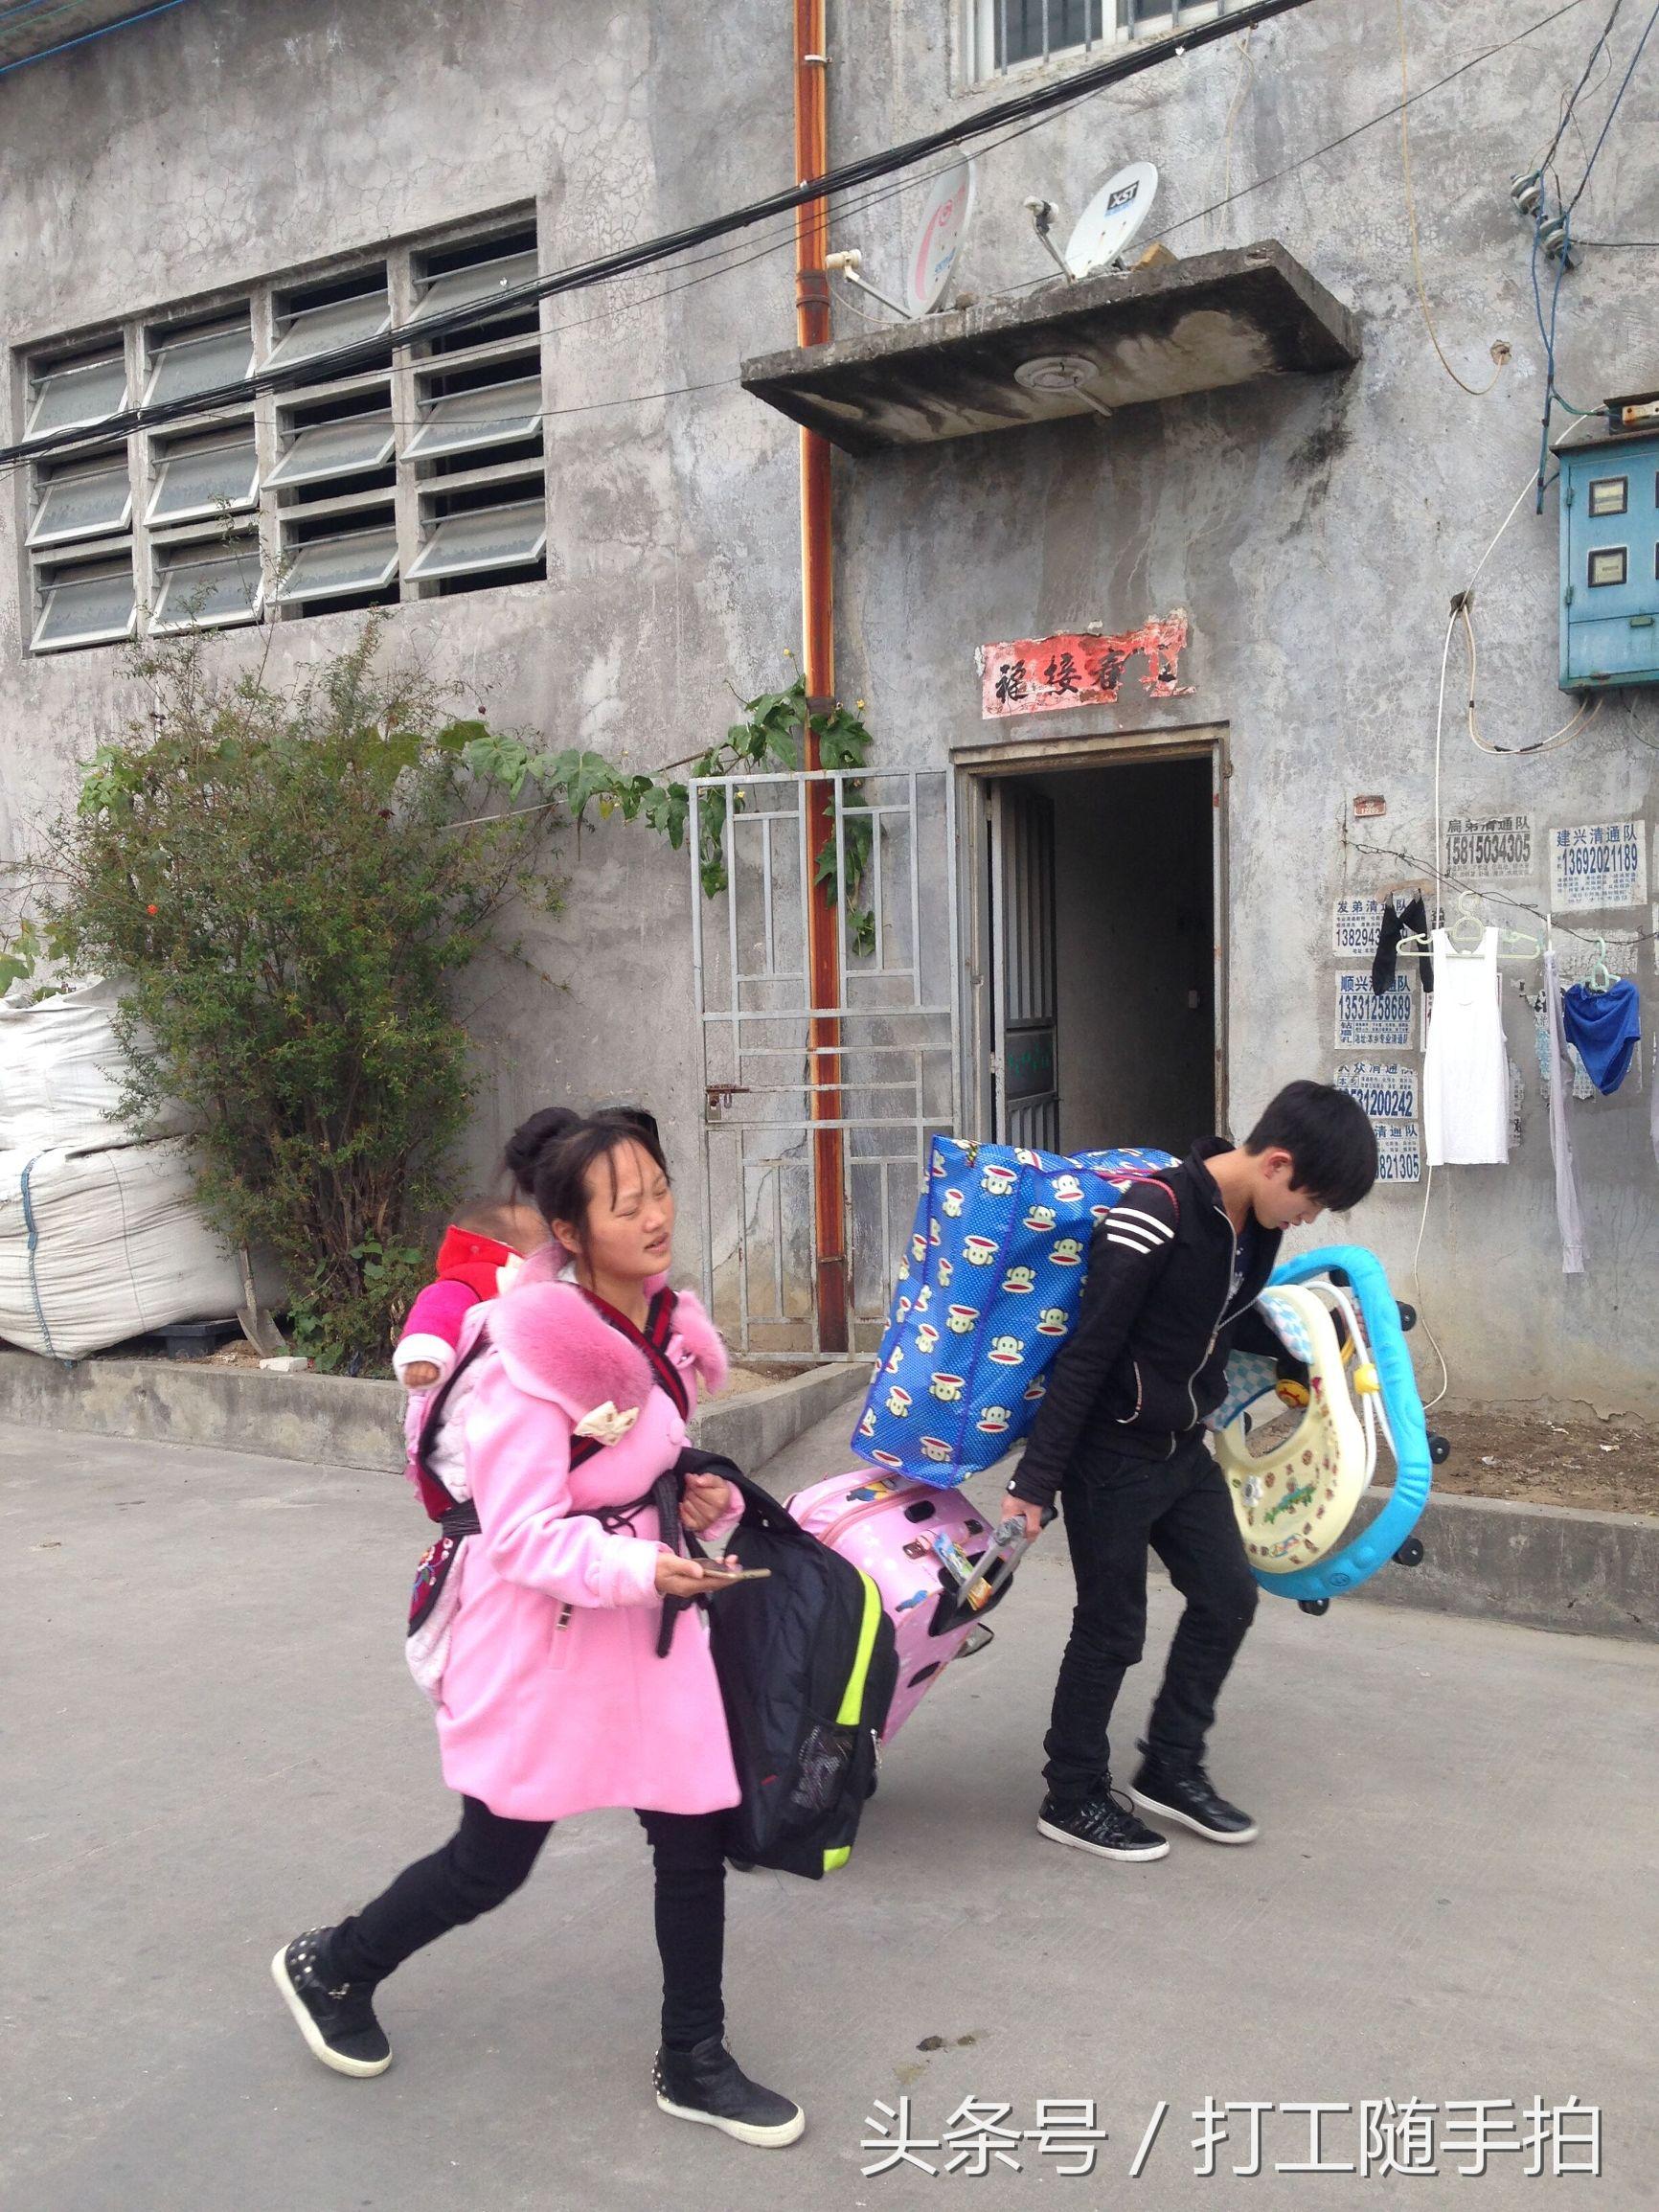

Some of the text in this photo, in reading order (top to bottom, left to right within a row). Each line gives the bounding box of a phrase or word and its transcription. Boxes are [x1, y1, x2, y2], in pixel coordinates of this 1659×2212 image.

[1110, 183, 1138, 208] XST
[1446, 833, 1531, 864] 15815034305
[1557, 824, 1637, 847] 建兴清通队
[1562, 843, 1638, 876] 13692021189
[1339, 994, 1411, 1020] 13531258689
